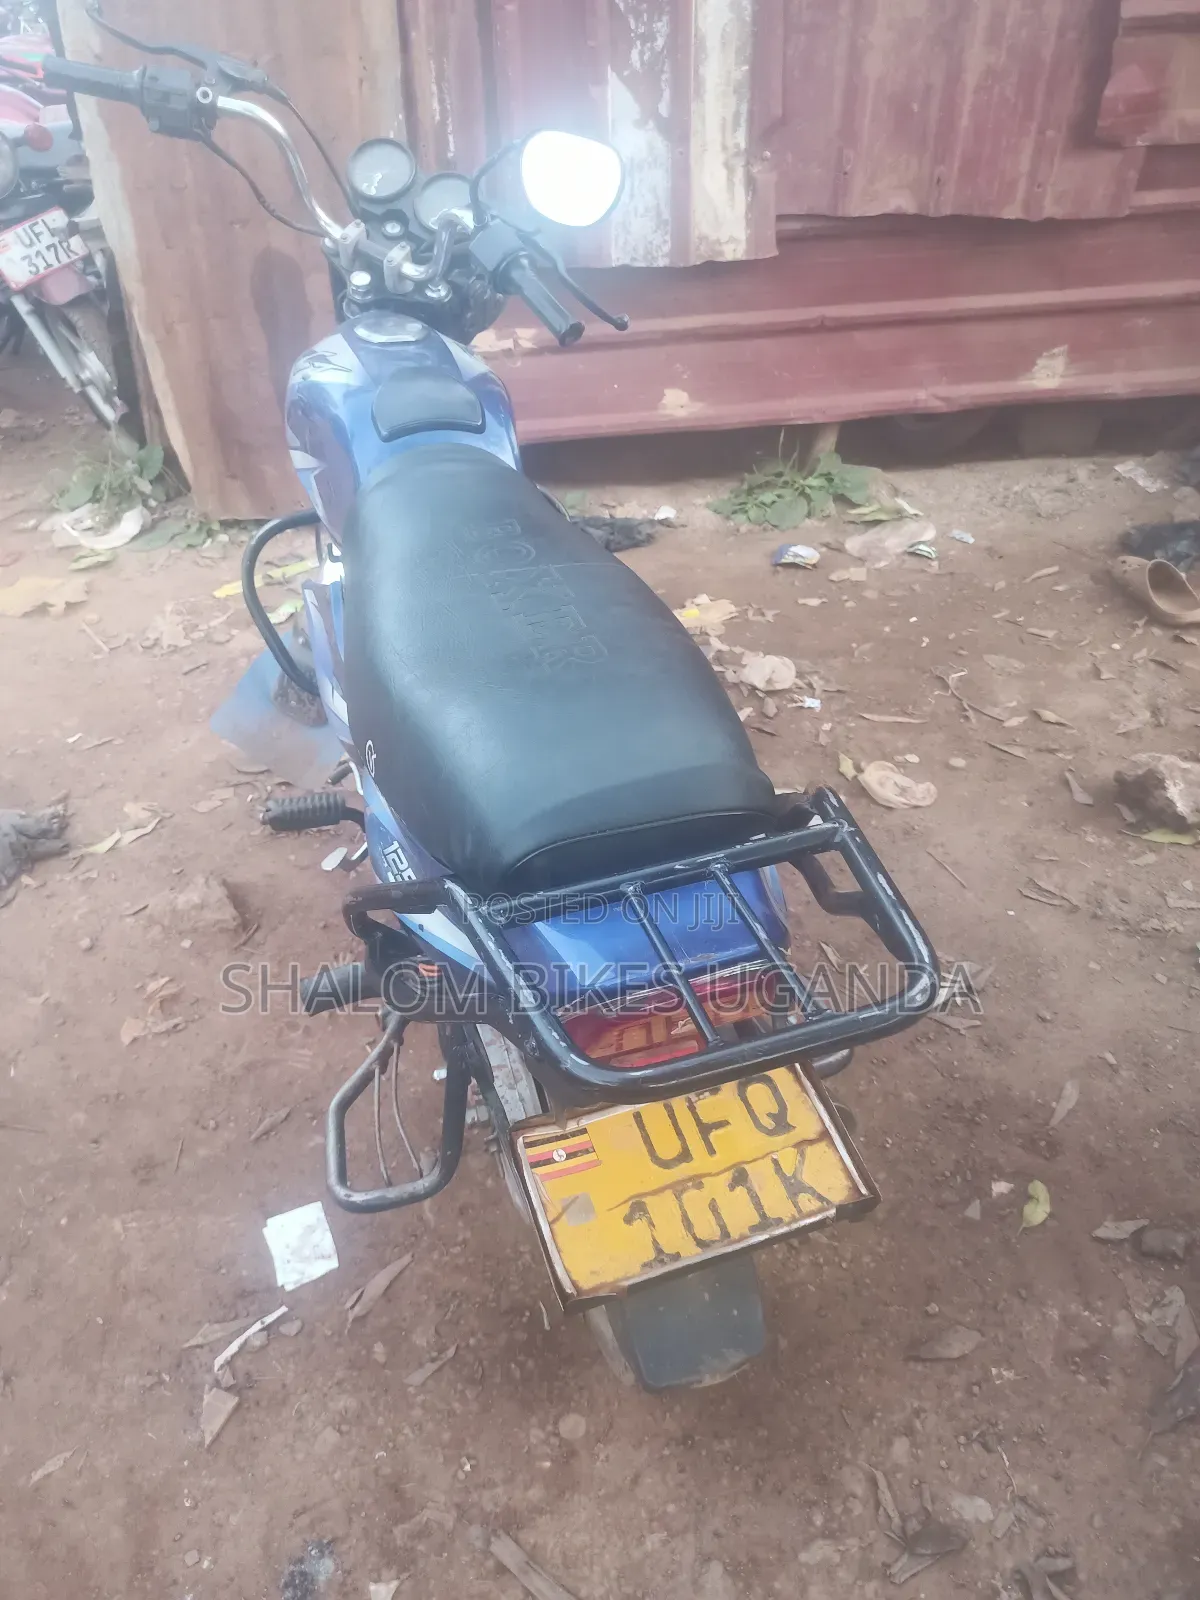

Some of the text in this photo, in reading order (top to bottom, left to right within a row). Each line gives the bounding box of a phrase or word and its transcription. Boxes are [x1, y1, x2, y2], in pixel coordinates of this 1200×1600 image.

[20, 239, 80, 276] 317R
[632, 1073, 797, 1171] UFQ
[622, 1148, 834, 1270] 101K
